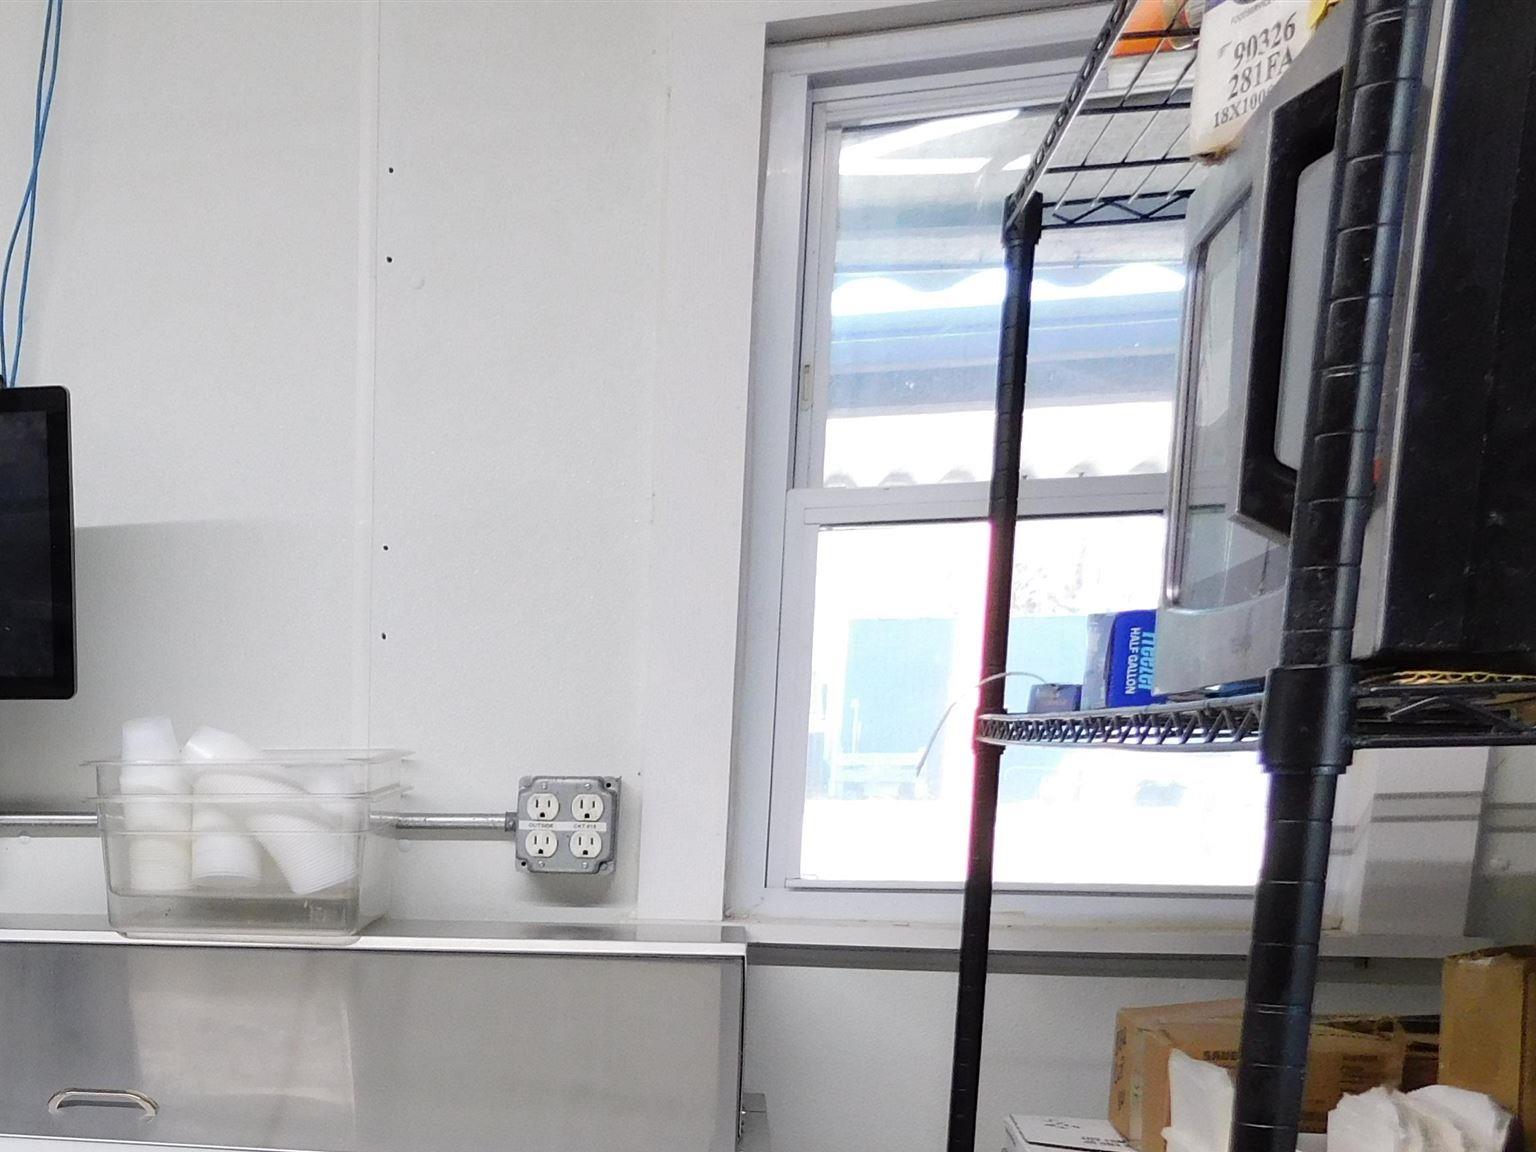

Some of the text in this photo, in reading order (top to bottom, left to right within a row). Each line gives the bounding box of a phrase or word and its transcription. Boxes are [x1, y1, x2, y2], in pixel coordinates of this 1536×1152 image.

[1233, 11, 1297, 70] 90326
[1228, 46, 1293, 100] 281FA
[1125, 627, 1141, 695] HALF GALLON
